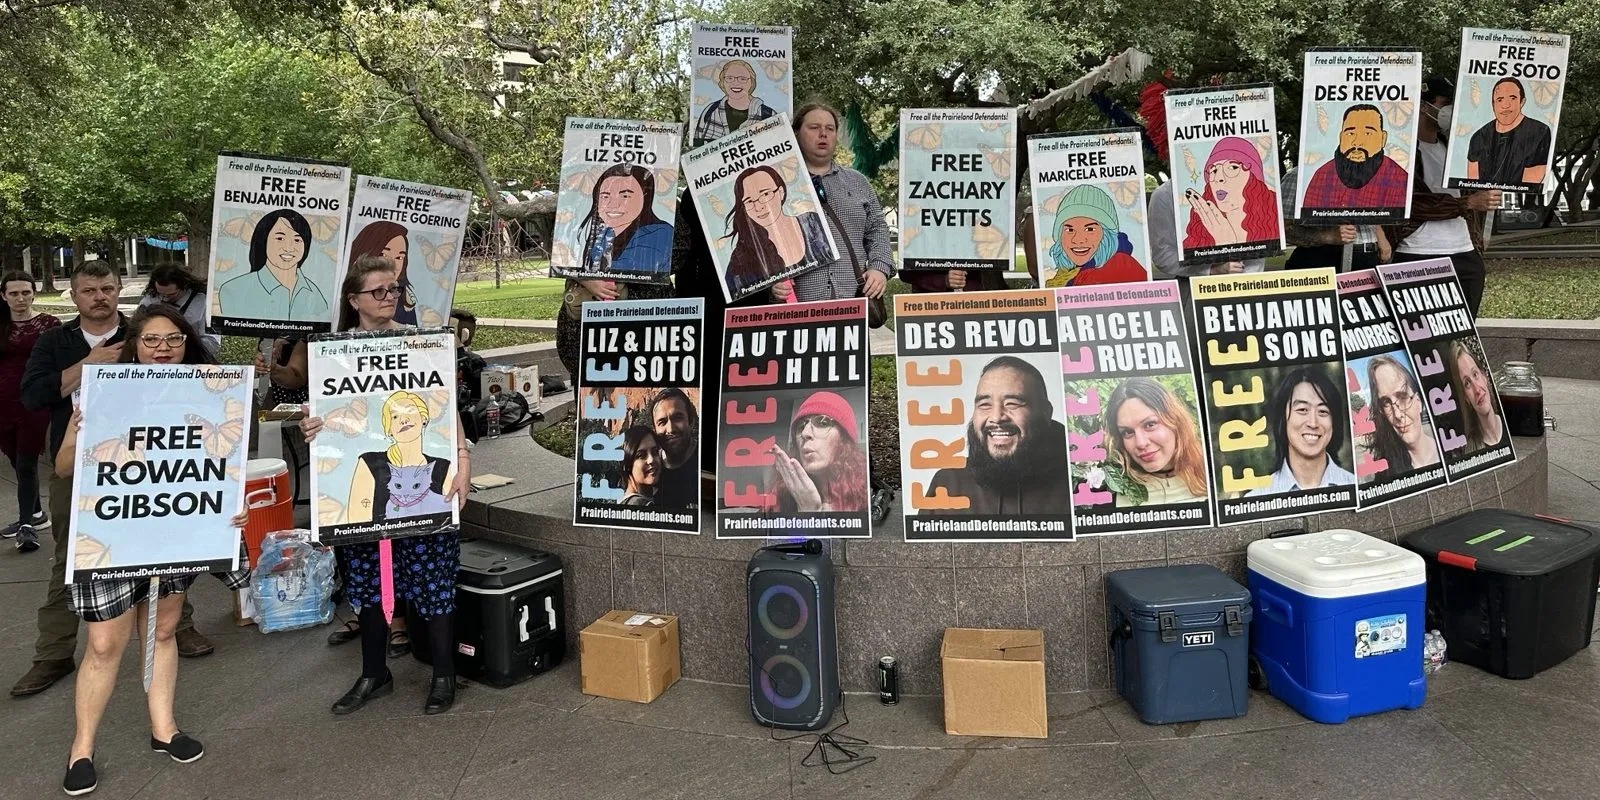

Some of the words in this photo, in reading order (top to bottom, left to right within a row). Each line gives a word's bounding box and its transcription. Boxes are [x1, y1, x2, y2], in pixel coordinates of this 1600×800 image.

[724, 36, 759, 48] FREE
[1472, 32, 1484, 41] Free
[1502, 35, 1532, 44] Prairieland
[1532, 37, 1563, 47] Defendants!
[698, 46, 740, 57] REBECCA
[742, 48, 786, 58] MORGAN
[1337, 56, 1346, 64] the
[1347, 56, 1378, 65] Prairieland
[1379, 56, 1414, 65] Defendants!
[1498, 45, 1535, 61] FREE
[1346, 68, 1380, 82] FREE
[1468, 59, 1508, 76] INES
[1511, 63, 1561, 80] SOTO
[1196, 97, 1205, 106] the
[1205, 95, 1234, 105] Prairieland
[1314, 85, 1347, 101] DES
[1353, 85, 1409, 101] REVOL
[910, 113, 923, 121] Free
[933, 113, 941, 121] the
[942, 113, 972, 121] Prairieland
[974, 113, 1008, 122] Defendants!
[1204, 106, 1237, 121] FREE
[570, 121, 583, 130] Free
[605, 123, 640, 132] Prairieland
[1173, 122, 1235, 140] AUTUMN
[1240, 119, 1270, 135] HILL
[600, 133, 644, 148] FREE
[690, 152, 703, 162] Free
[710, 145, 718, 154] the
[719, 132, 748, 149] Prairieland
[749, 120, 780, 136] Defendants!
[1070, 139, 1100, 148] Prairieland
[585, 149, 608, 162] LIZ
[613, 150, 657, 164] SOTO
[721, 140, 756, 164] FREE
[1067, 151, 1107, 167] FREE
[229, 161, 243, 170] Free
[254, 164, 264, 172] the
[266, 164, 302, 176] Prairieland
[303, 167, 341, 179] Defendants!
[694, 158, 744, 189] MEAGAN
[746, 140, 792, 167] MORRIS
[931, 154, 982, 172] FREE
[1038, 167, 1097, 183] MARICELA
[1100, 165, 1137, 179] RUEDA
[260, 176, 305, 194] FREE
[400, 184, 431, 196] Prairieland
[909, 181, 1005, 200] ZACHARY
[1458, 181, 1529, 191] PrairielandDefendants.com
[224, 191, 294, 206] BENJAMIN
[298, 196, 339, 210] SONG
[396, 196, 431, 212] FREE
[358, 206, 408, 222] JANETTE
[410, 213, 460, 228] GOERING
[920, 209, 992, 227] EVETTS
[1194, 244, 1266, 257] PrairielandDefendants.com
[914, 261, 994, 270] PrairielandDefendants.com
[741, 260, 819, 294] PrairielandDefendants.com
[1199, 283, 1216, 293] Free
[1218, 282, 1231, 292] the
[1233, 278, 1279, 291] Prairieland
[1280, 276, 1329, 288] Defendants!
[904, 301, 922, 311] Free
[924, 301, 938, 310] the
[939, 298, 990, 310] Prairieland
[992, 297, 1047, 309] Defendants!
[1064, 292, 1115, 304] Prairieland
[1117, 287, 1172, 300] Defendants!
[1392, 282, 1462, 314] SAVANNA
[587, 308, 602, 317] Free
[603, 308, 614, 317] the
[615, 306, 653, 317] Prairieland
[655, 305, 698, 315] Defendants!
[731, 314, 748, 324] Free
[750, 312, 763, 322] the
[764, 309, 809, 321] Prairieland
[810, 305, 860, 317] Defendants!
[1203, 298, 1333, 333] BENJAMIN
[224, 320, 313, 331] PrairielandDefendants.com
[1059, 309, 1178, 342] ARICELA
[1428, 308, 1471, 336] BATTEN
[588, 328, 618, 353] LIZ
[624, 330, 638, 352] &
[644, 325, 695, 352] INES
[729, 325, 859, 358] AUTUMN
[904, 321, 955, 350] DES
[965, 318, 1052, 348] REVOL
[1342, 321, 1400, 353] MORRIS
[321, 346, 336, 355] Free
[338, 345, 347, 354] all
[349, 345, 360, 354] the
[362, 342, 401, 354] Prairieland
[1264, 329, 1336, 361] SONG
[357, 353, 409, 372] FREE
[1098, 341, 1184, 372] RUEDA
[96, 368, 116, 379] Free
[118, 369, 130, 379] all
[131, 369, 144, 379] the
[146, 368, 194, 379] Prairieland
[195, 368, 243, 380] Defendants!
[634, 356, 696, 382] SOTO
[785, 355, 860, 384] HILL
[322, 371, 445, 396] SAVANNA
[1401, 314, 1466, 452] FREE
[1207, 335, 1272, 497] FREE
[127, 425, 203, 452] FREE
[581, 356, 629, 504] FREE
[724, 360, 779, 507] FREE
[906, 358, 970, 510] FREE
[1448, 447, 1511, 474] PrairielandDefendants.com
[96, 458, 226, 486] ROWAN
[94, 490, 223, 520] GIBSON
[1225, 490, 1350, 516] PrairielandDefendants.com
[581, 506, 693, 524] PrairielandDefendants.com
[724, 518, 862, 529] PrairielandDefendants.com
[334, 517, 433, 536] PrairielandDefendants.com
[913, 518, 1064, 532] PrairielandDefendants.com
[91, 564, 210, 580] PrairielandDefendants.com
[1185, 634, 1211, 644] YETI
